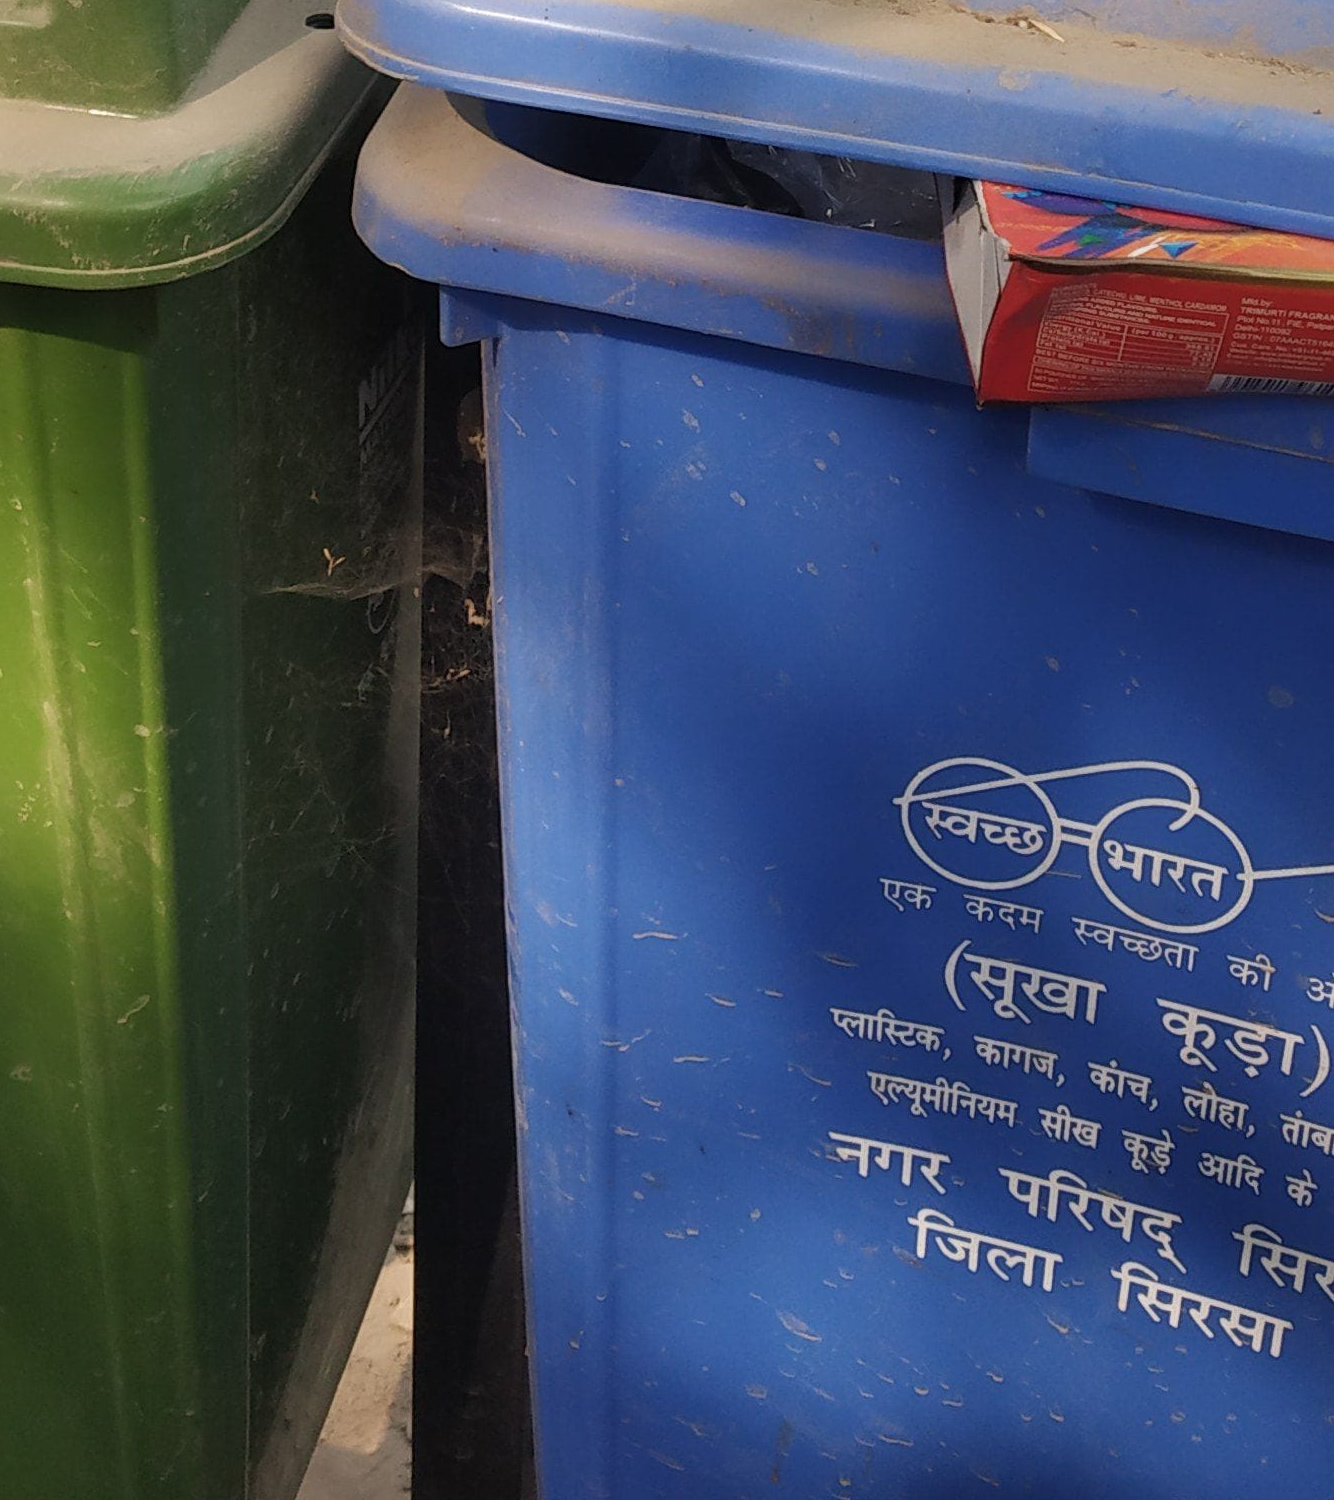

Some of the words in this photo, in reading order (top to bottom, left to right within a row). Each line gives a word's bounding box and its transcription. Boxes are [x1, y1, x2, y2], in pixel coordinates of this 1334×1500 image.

[1241, 307, 1287, 317] TRIMURTI
[921, 801, 1047, 855] स्वच्छ
[1103, 839, 1229, 901] भारत
[879, 878, 937, 912] एक
[963, 894, 1044, 933] कदम
[1071, 917, 1200, 972] स्वच्छता
[1226, 953, 1276, 991] की
[827, 1131, 951, 1195] नगर
[1038, 1104, 1102, 1149] सीख
[1121, 1129, 1176, 1174] कूड़े
[1198, 1152, 1265, 1195] आदि
[1285, 1169, 1318, 1206] के
[907, 1208, 1063, 1292] जिला
[1110, 1261, 1293, 1358] सिरसा
